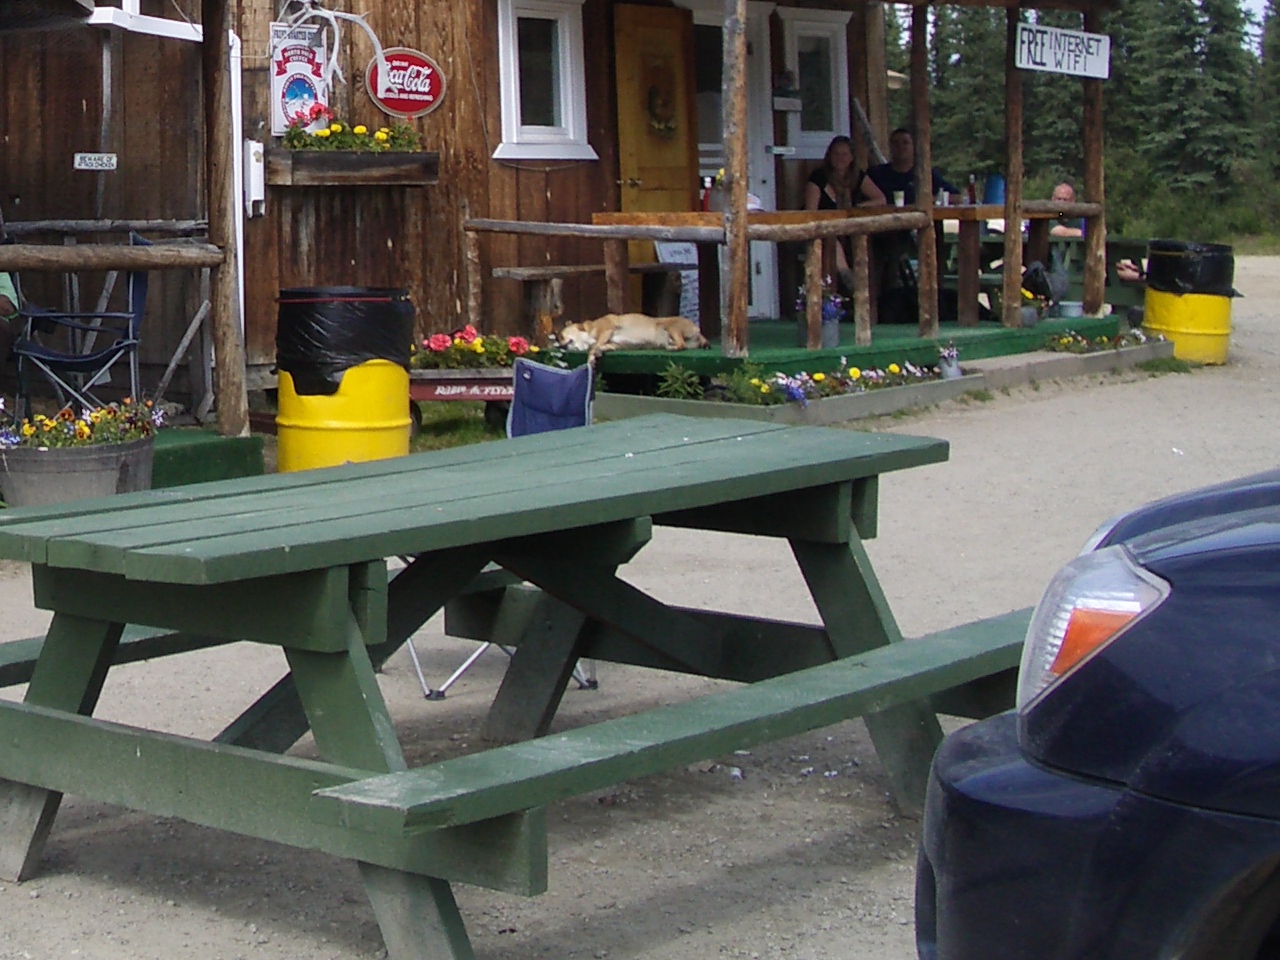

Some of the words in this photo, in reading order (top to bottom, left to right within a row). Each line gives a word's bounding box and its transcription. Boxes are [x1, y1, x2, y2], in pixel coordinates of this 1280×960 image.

[1020, 27, 1048, 67] FREE
[1050, 31, 1102, 56] INTERNET
[1054, 51, 1087, 72] WIFI
